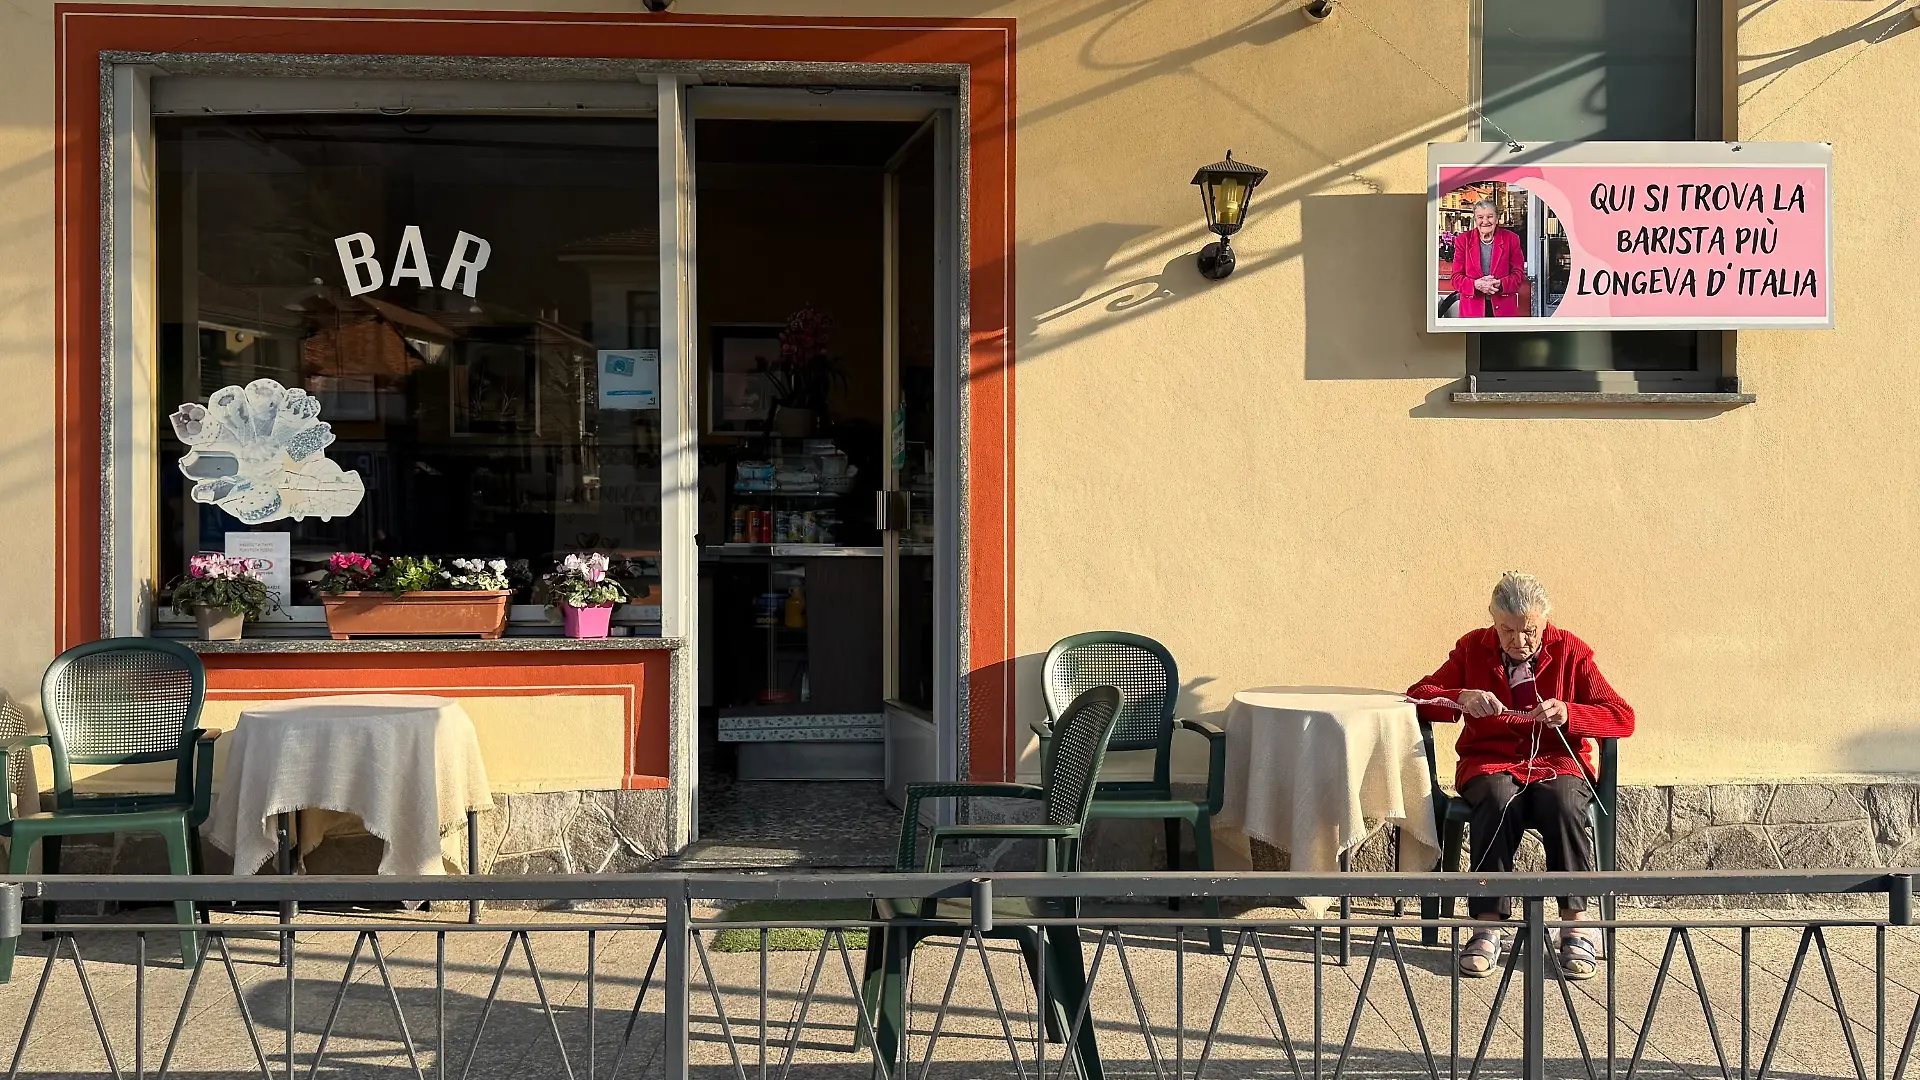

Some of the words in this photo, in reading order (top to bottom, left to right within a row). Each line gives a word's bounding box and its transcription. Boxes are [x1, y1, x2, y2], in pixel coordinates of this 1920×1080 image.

[1590, 183, 1635, 214] QUI
[1643, 184, 1669, 212] SI
[1676, 182, 1764, 213] TROVA
[1772, 183, 1805, 213] LA
[1617, 226, 1725, 255] BARISTA
[1735, 217, 1778, 255] PIÙ
[334, 225, 492, 298] BAR
[1577, 266, 1696, 297] LONGEVA
